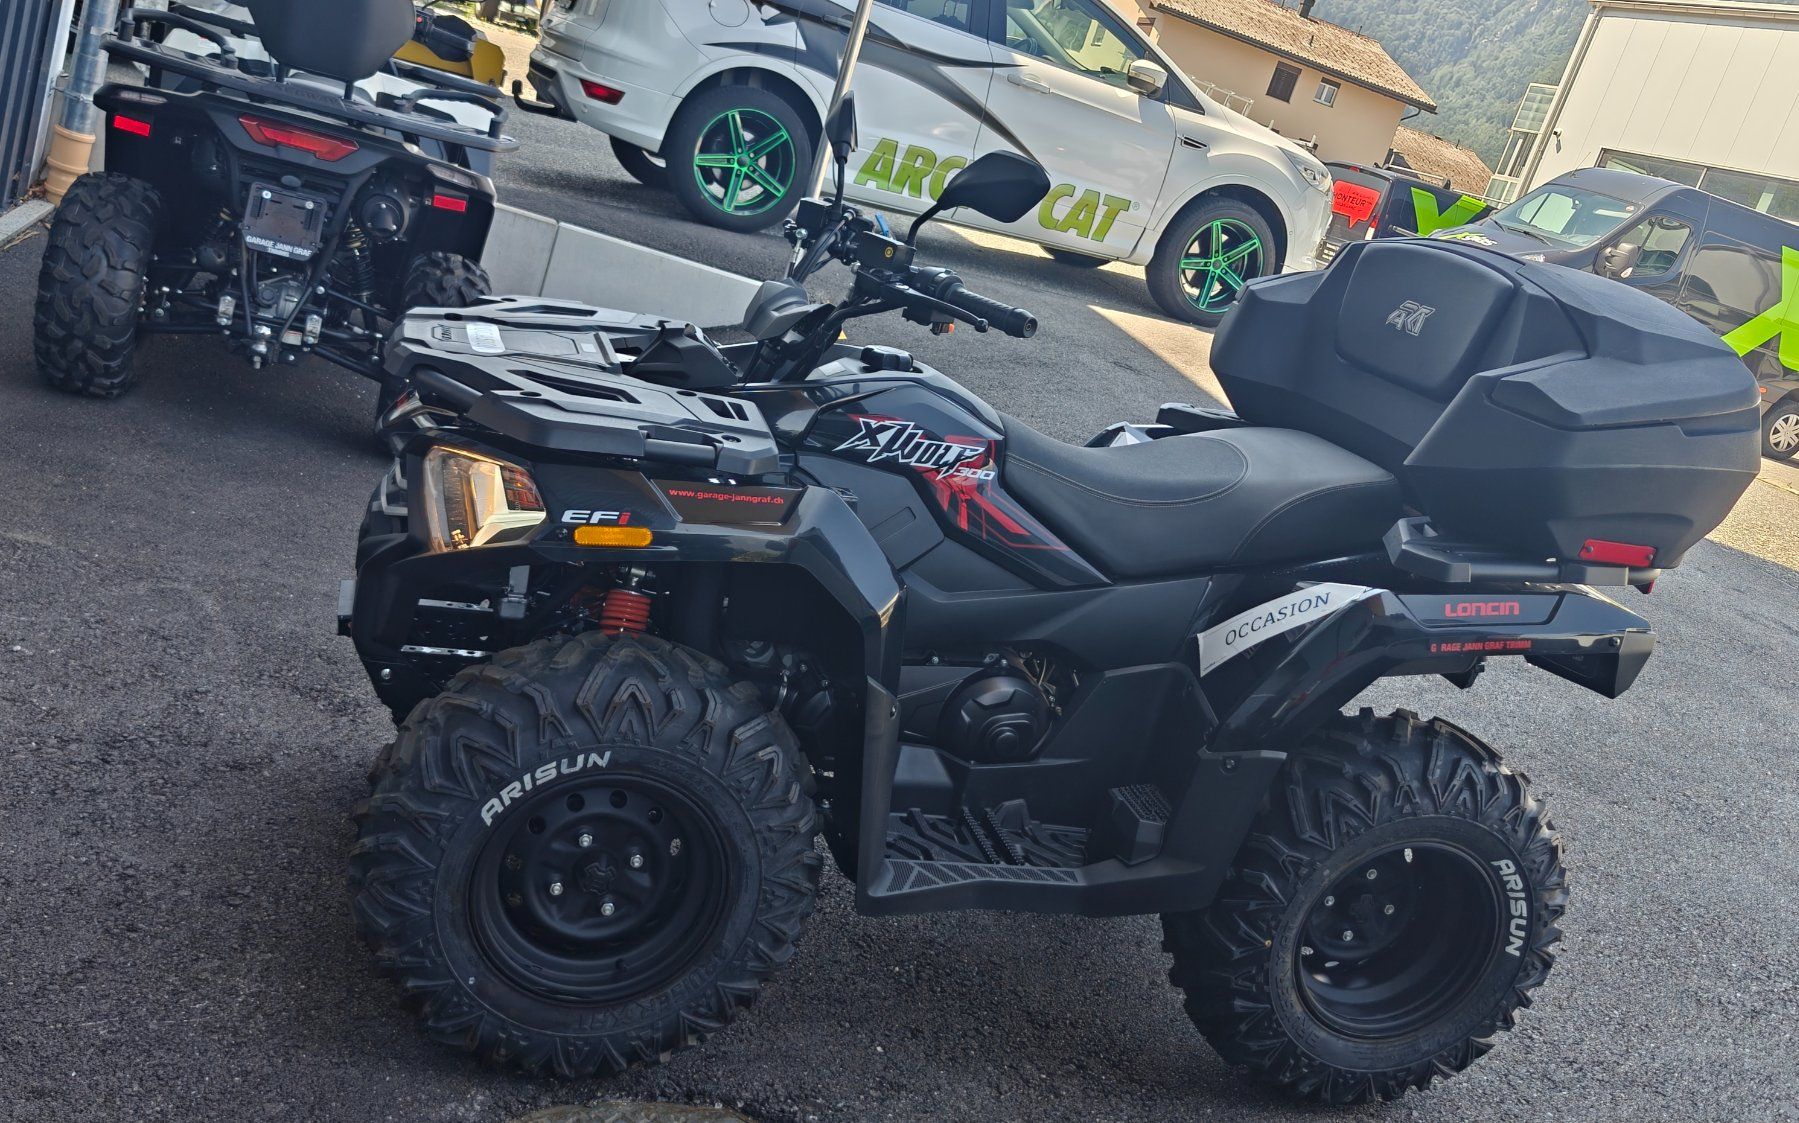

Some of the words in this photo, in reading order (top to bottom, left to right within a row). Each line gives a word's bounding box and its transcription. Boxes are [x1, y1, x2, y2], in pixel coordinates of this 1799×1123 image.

[1334, 192, 1367, 206] ONTEUR
[1037, 183, 1131, 243] CAT
[246, 235, 275, 248] GARAGE
[275, 243, 293, 253] JANN
[293, 247, 313, 257] GRAF
[953, 466, 996, 481] 300
[668, 487, 785, 505] www.garage-janngraf.ch
[1225, 591, 1331, 646] OCCASION
[1463, 641, 1484, 651] JANN
[1484, 640, 1505, 651] GRAF
[480, 750, 612, 828] ARISUN
[1490, 859, 1528, 957] ARISUN
